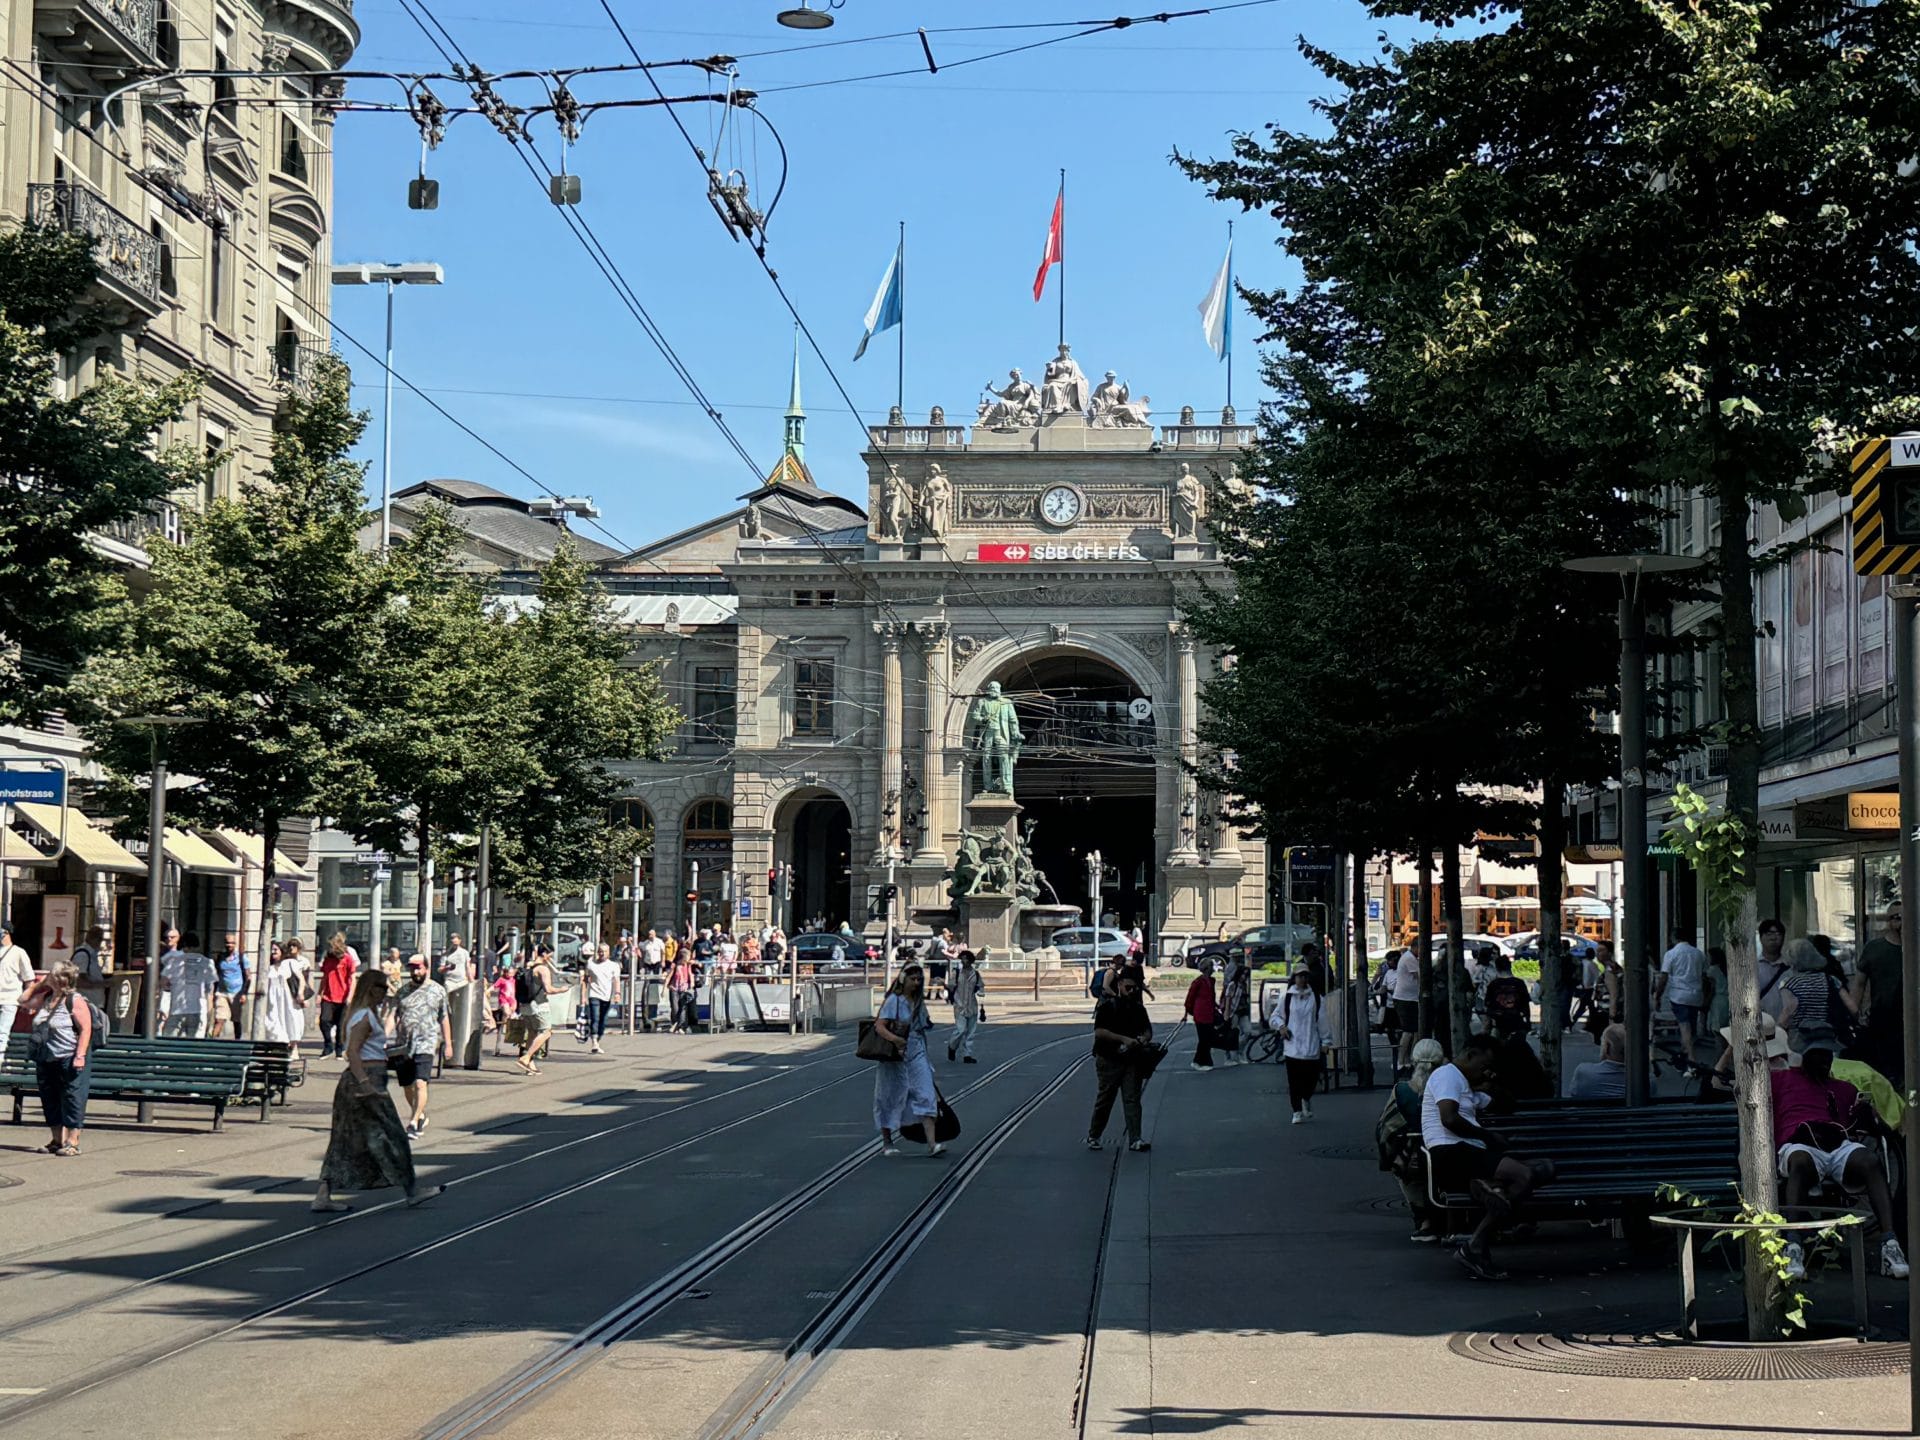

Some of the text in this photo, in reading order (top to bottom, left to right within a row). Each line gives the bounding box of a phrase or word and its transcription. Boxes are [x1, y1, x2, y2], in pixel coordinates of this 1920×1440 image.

[1033, 545, 1140, 560] SBB CFF FFS
[1134, 703, 1147, 714] 12
